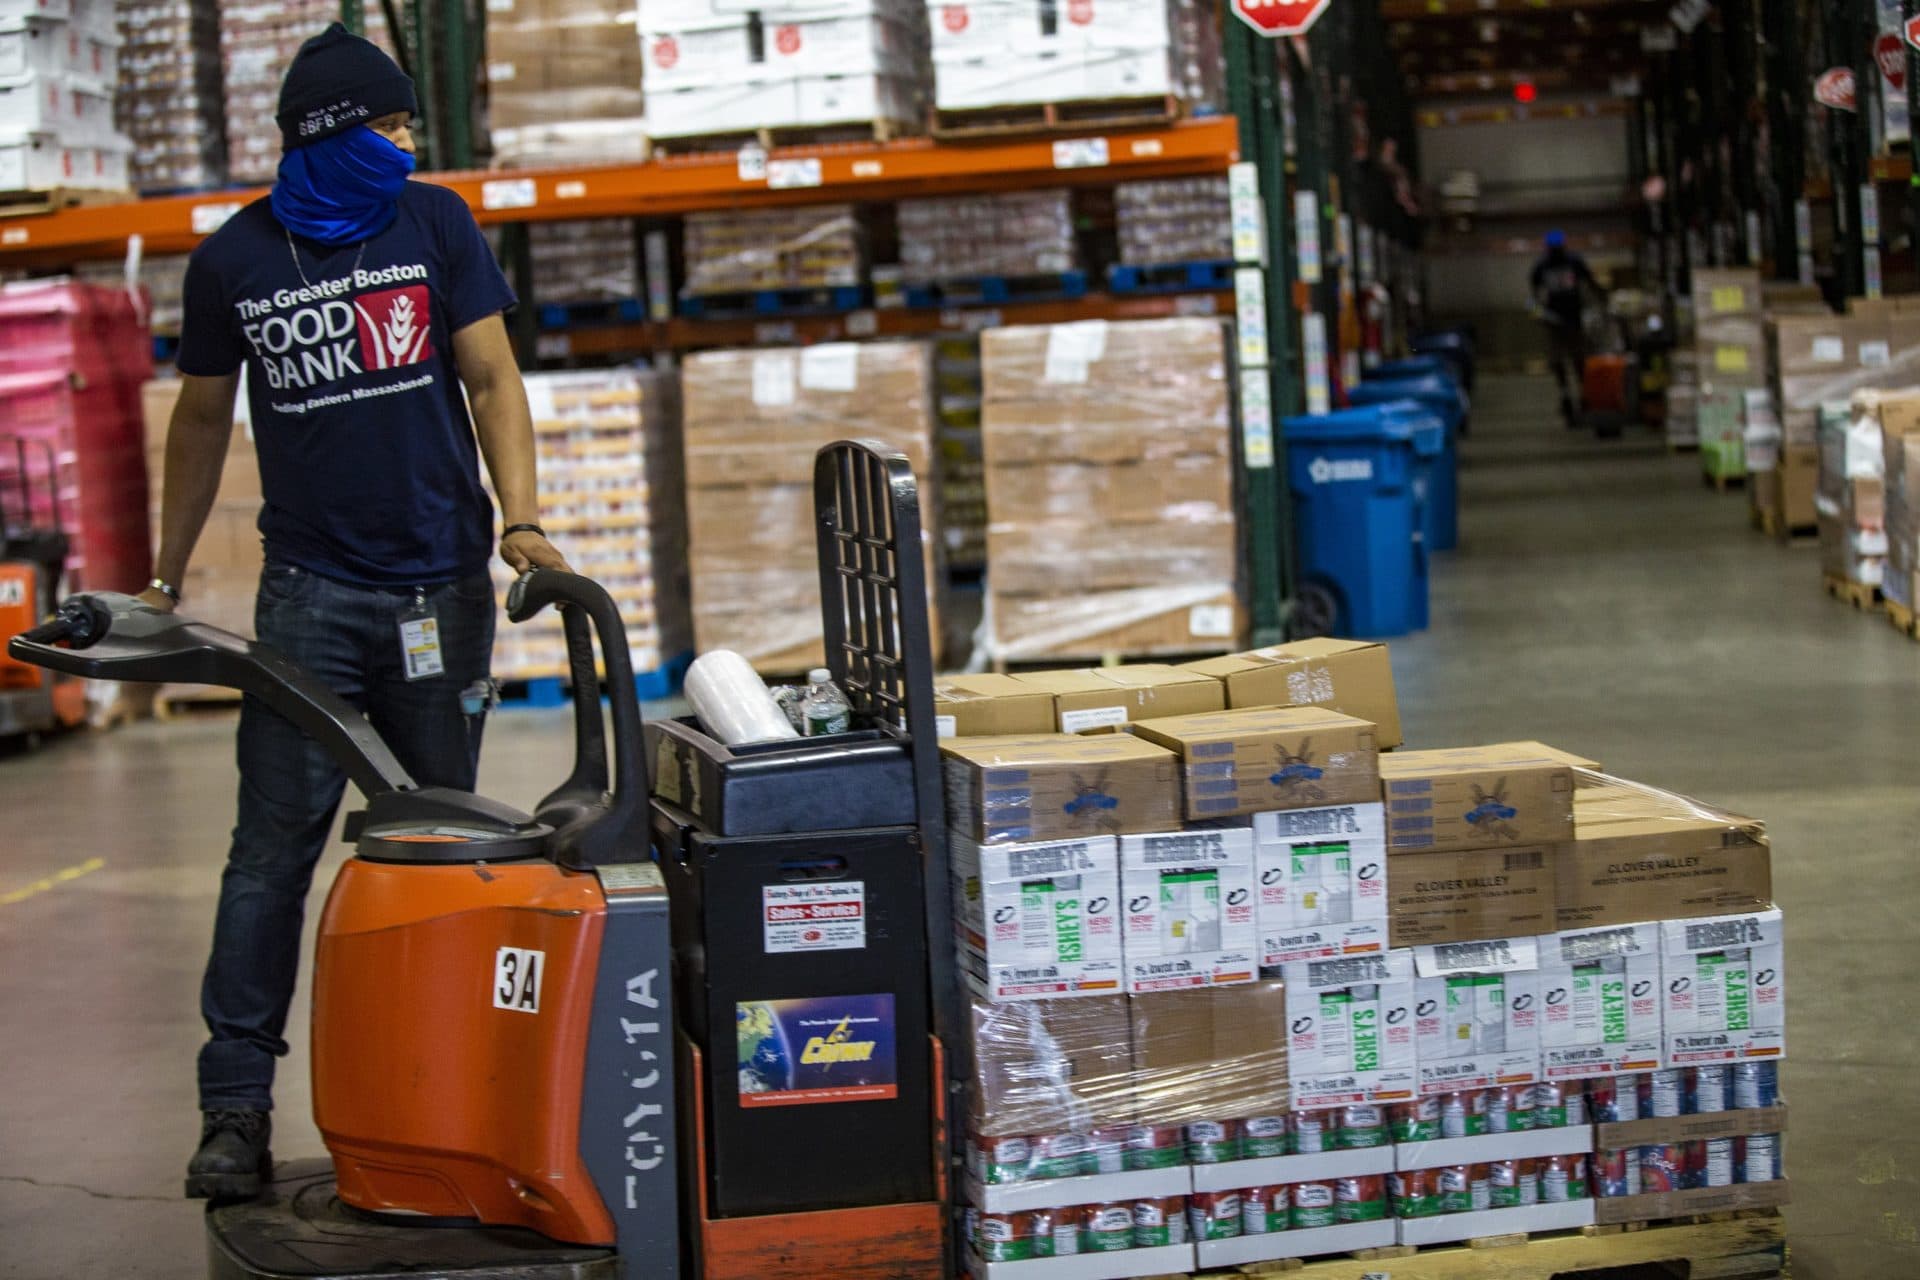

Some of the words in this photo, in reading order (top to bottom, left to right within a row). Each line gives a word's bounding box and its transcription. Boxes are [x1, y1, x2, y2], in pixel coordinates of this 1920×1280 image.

[235, 298, 273, 320] The
[273, 276, 351, 308] Greater
[352, 263, 428, 289] Boston
[243, 300, 356, 356] FOOD
[261, 338, 364, 390] BANK
[307, 393, 351, 410] Eastern
[1414, 879, 1464, 893] CLOVER
[1465, 875, 1509, 889] VALLEY
[1607, 859, 1655, 874] CLOVER
[1656, 856, 1700, 870] VALLEY
[499, 951, 537, 1010] 3A
